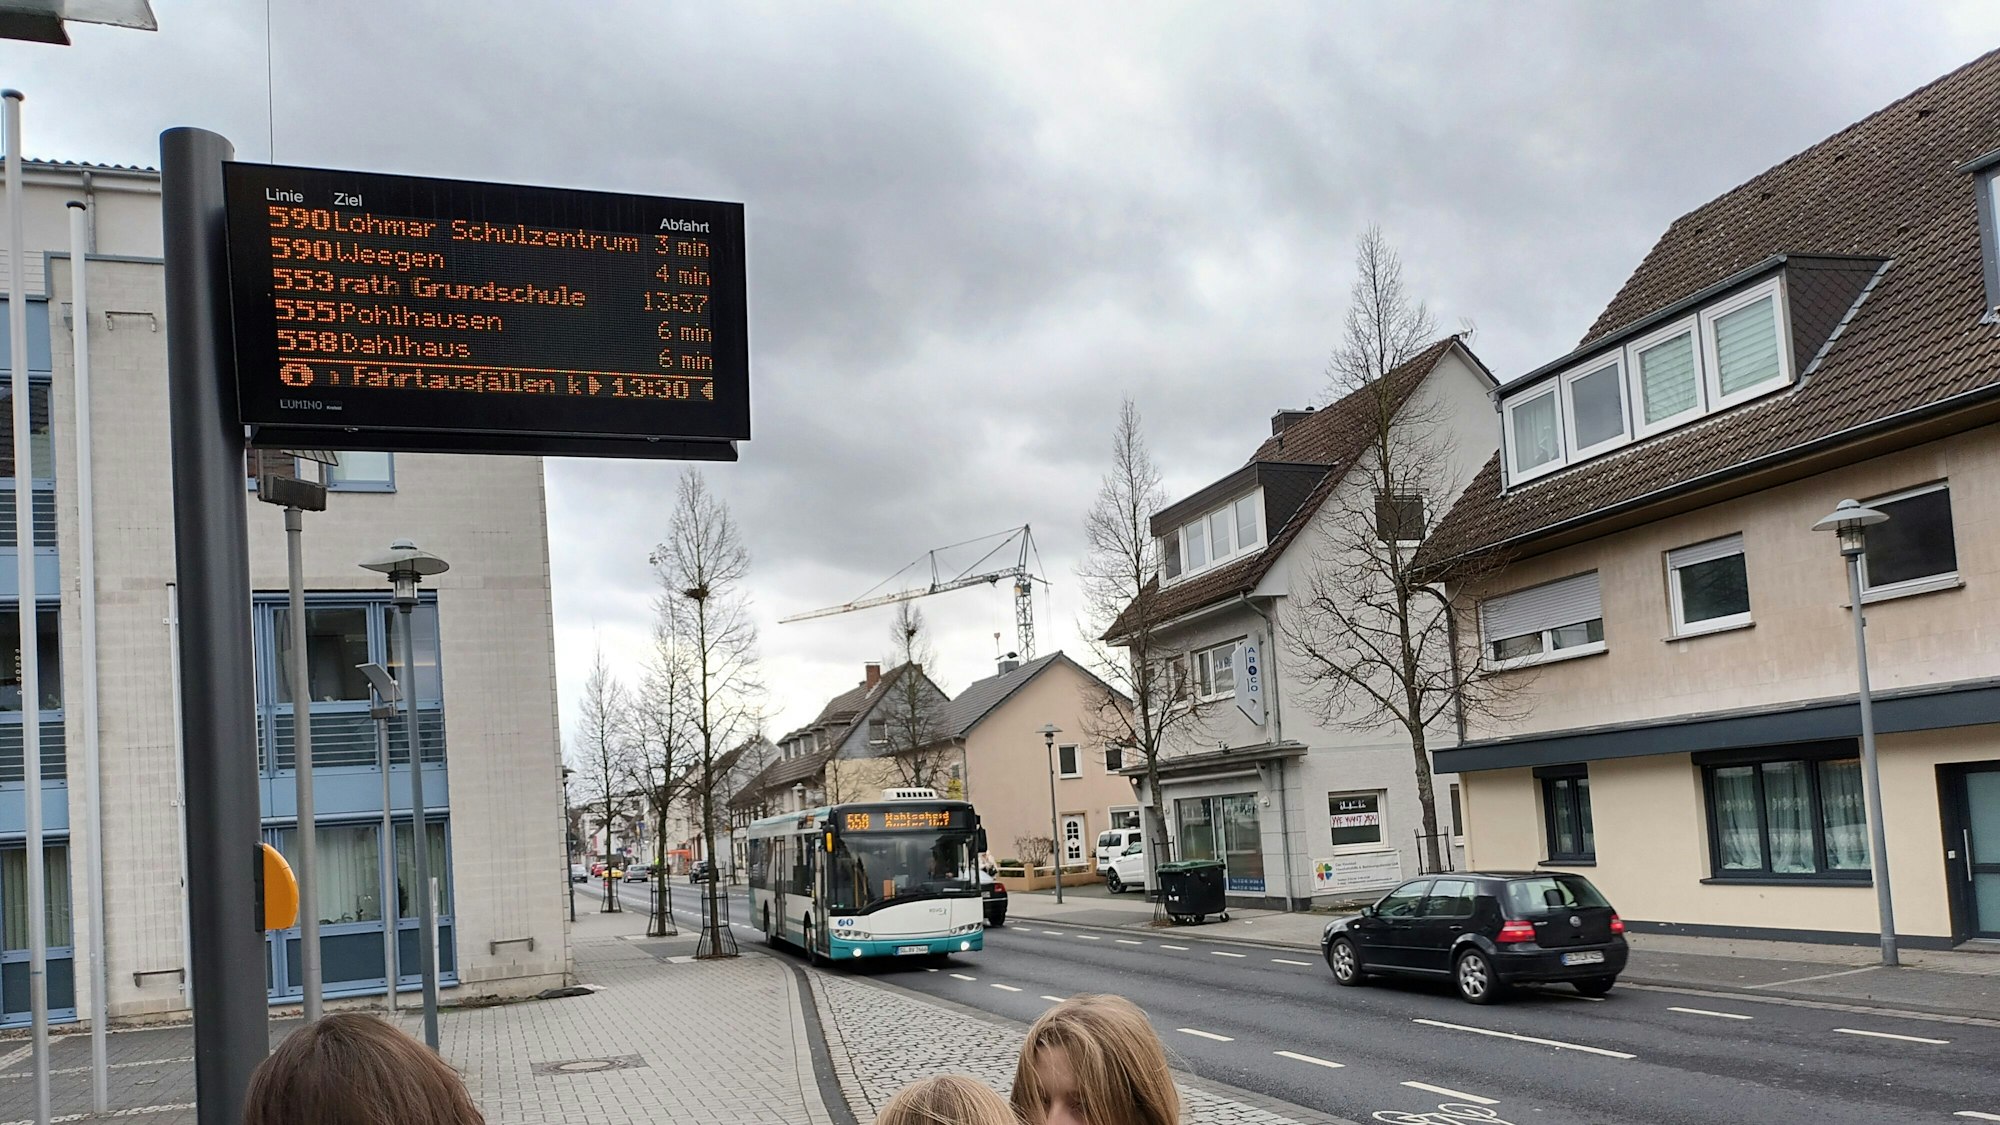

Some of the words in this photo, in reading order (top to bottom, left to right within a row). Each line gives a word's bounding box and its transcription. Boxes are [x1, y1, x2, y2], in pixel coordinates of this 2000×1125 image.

[265, 188, 304, 203] Linie
[333, 192, 363, 207] Ziel
[269, 206, 331, 231] 590
[334, 210, 437, 238] Lohmar
[452, 219, 639, 253] Schulzentrum
[654, 234, 669, 255] 3
[677, 237, 710, 258] min
[659, 218, 710, 234] Abfahrt
[271, 237, 333, 262] 590
[336, 242, 445, 272] Weegen
[655, 263, 670, 283] 4
[678, 265, 711, 287] min
[273, 268, 335, 292] 553
[339, 274, 400, 296] rath
[409, 276, 587, 307] Grundschule
[644, 290, 709, 314] 13:37
[275, 298, 337, 322] 555
[340, 302, 502, 331] Pohlhausen
[657, 320, 673, 341] 6
[680, 322, 713, 343] min
[277, 329, 338, 353] 558
[341, 332, 471, 359] Dahlhaus
[659, 349, 674, 369] 6
[681, 351, 714, 370] min
[352, 365, 556, 394] Fahrtausfällen
[611, 376, 690, 400] 13:30
[279, 399, 323, 410] LUMINO
